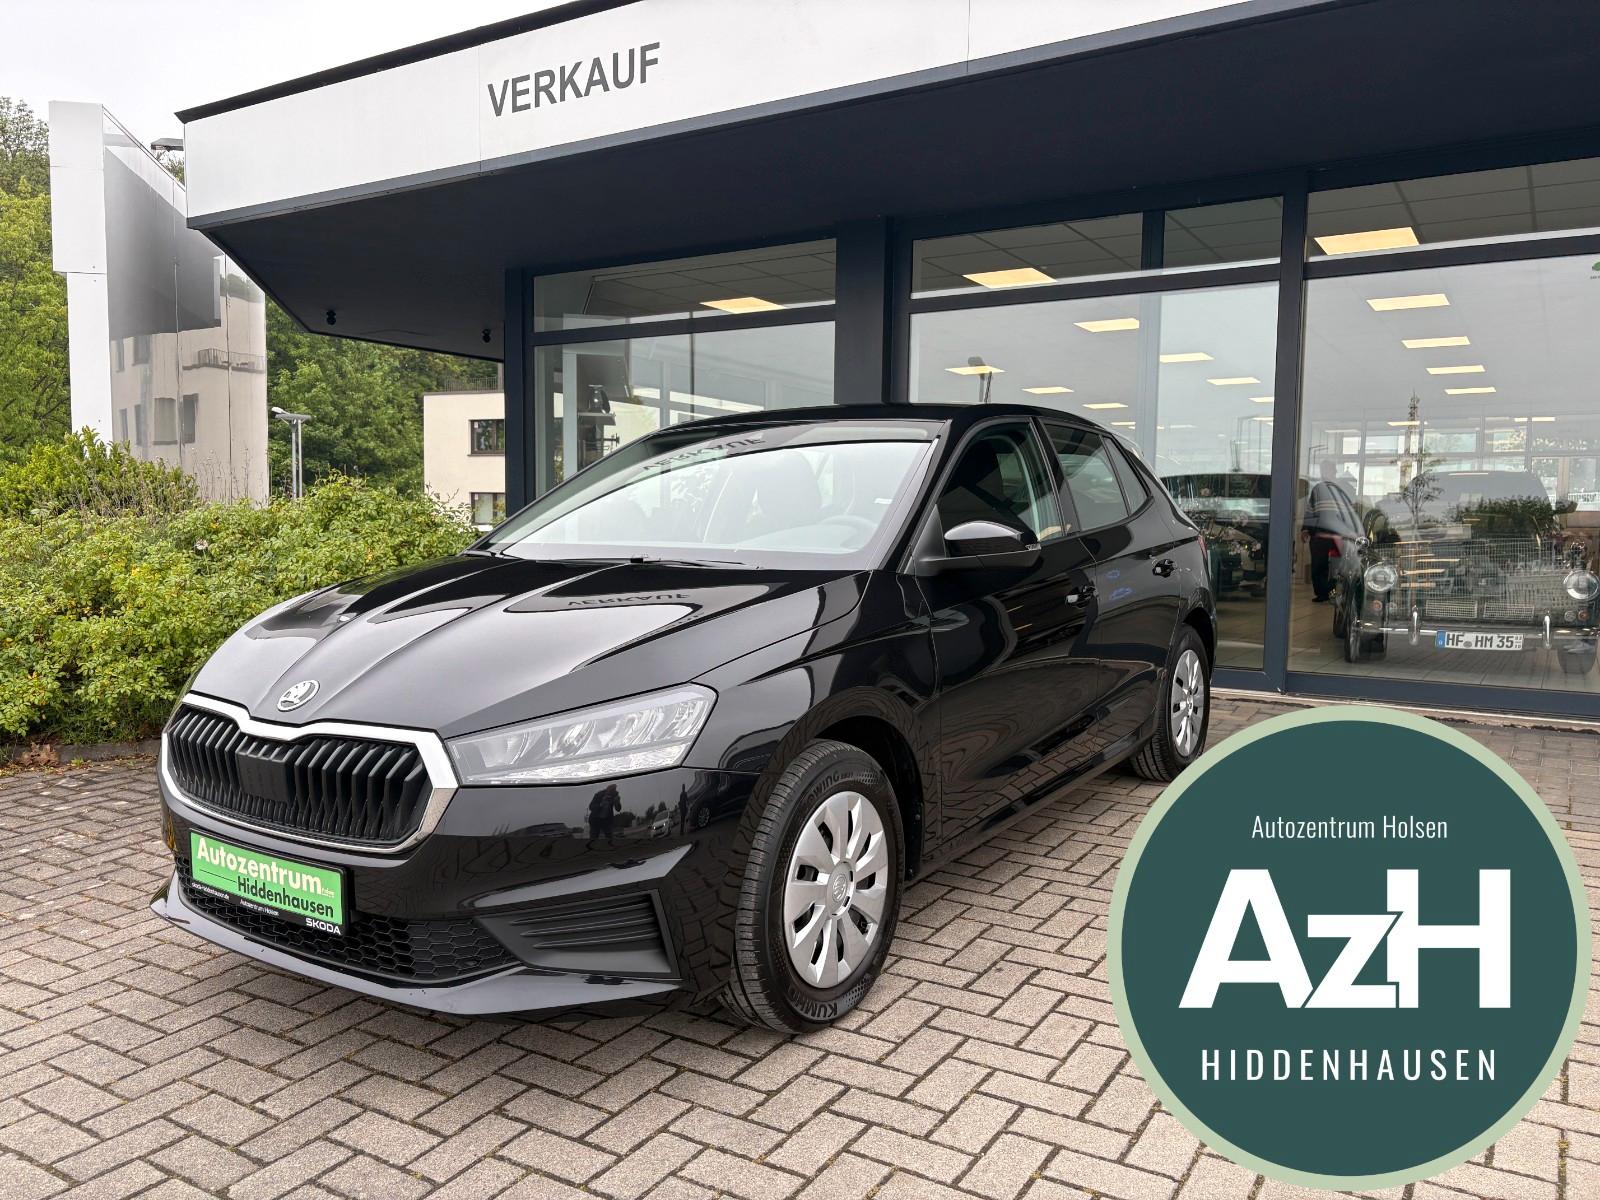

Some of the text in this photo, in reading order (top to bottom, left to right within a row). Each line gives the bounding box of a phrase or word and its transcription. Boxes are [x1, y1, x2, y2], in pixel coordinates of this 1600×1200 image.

[488, 42, 660, 117] VERKAUF
[1446, 634, 1464, 646] HF
[1475, 636, 1494, 648] HM
[1496, 636, 1514, 649] 35
[197, 837, 322, 895] Autozentrum
[237, 875, 334, 918] Hiddenhausen
